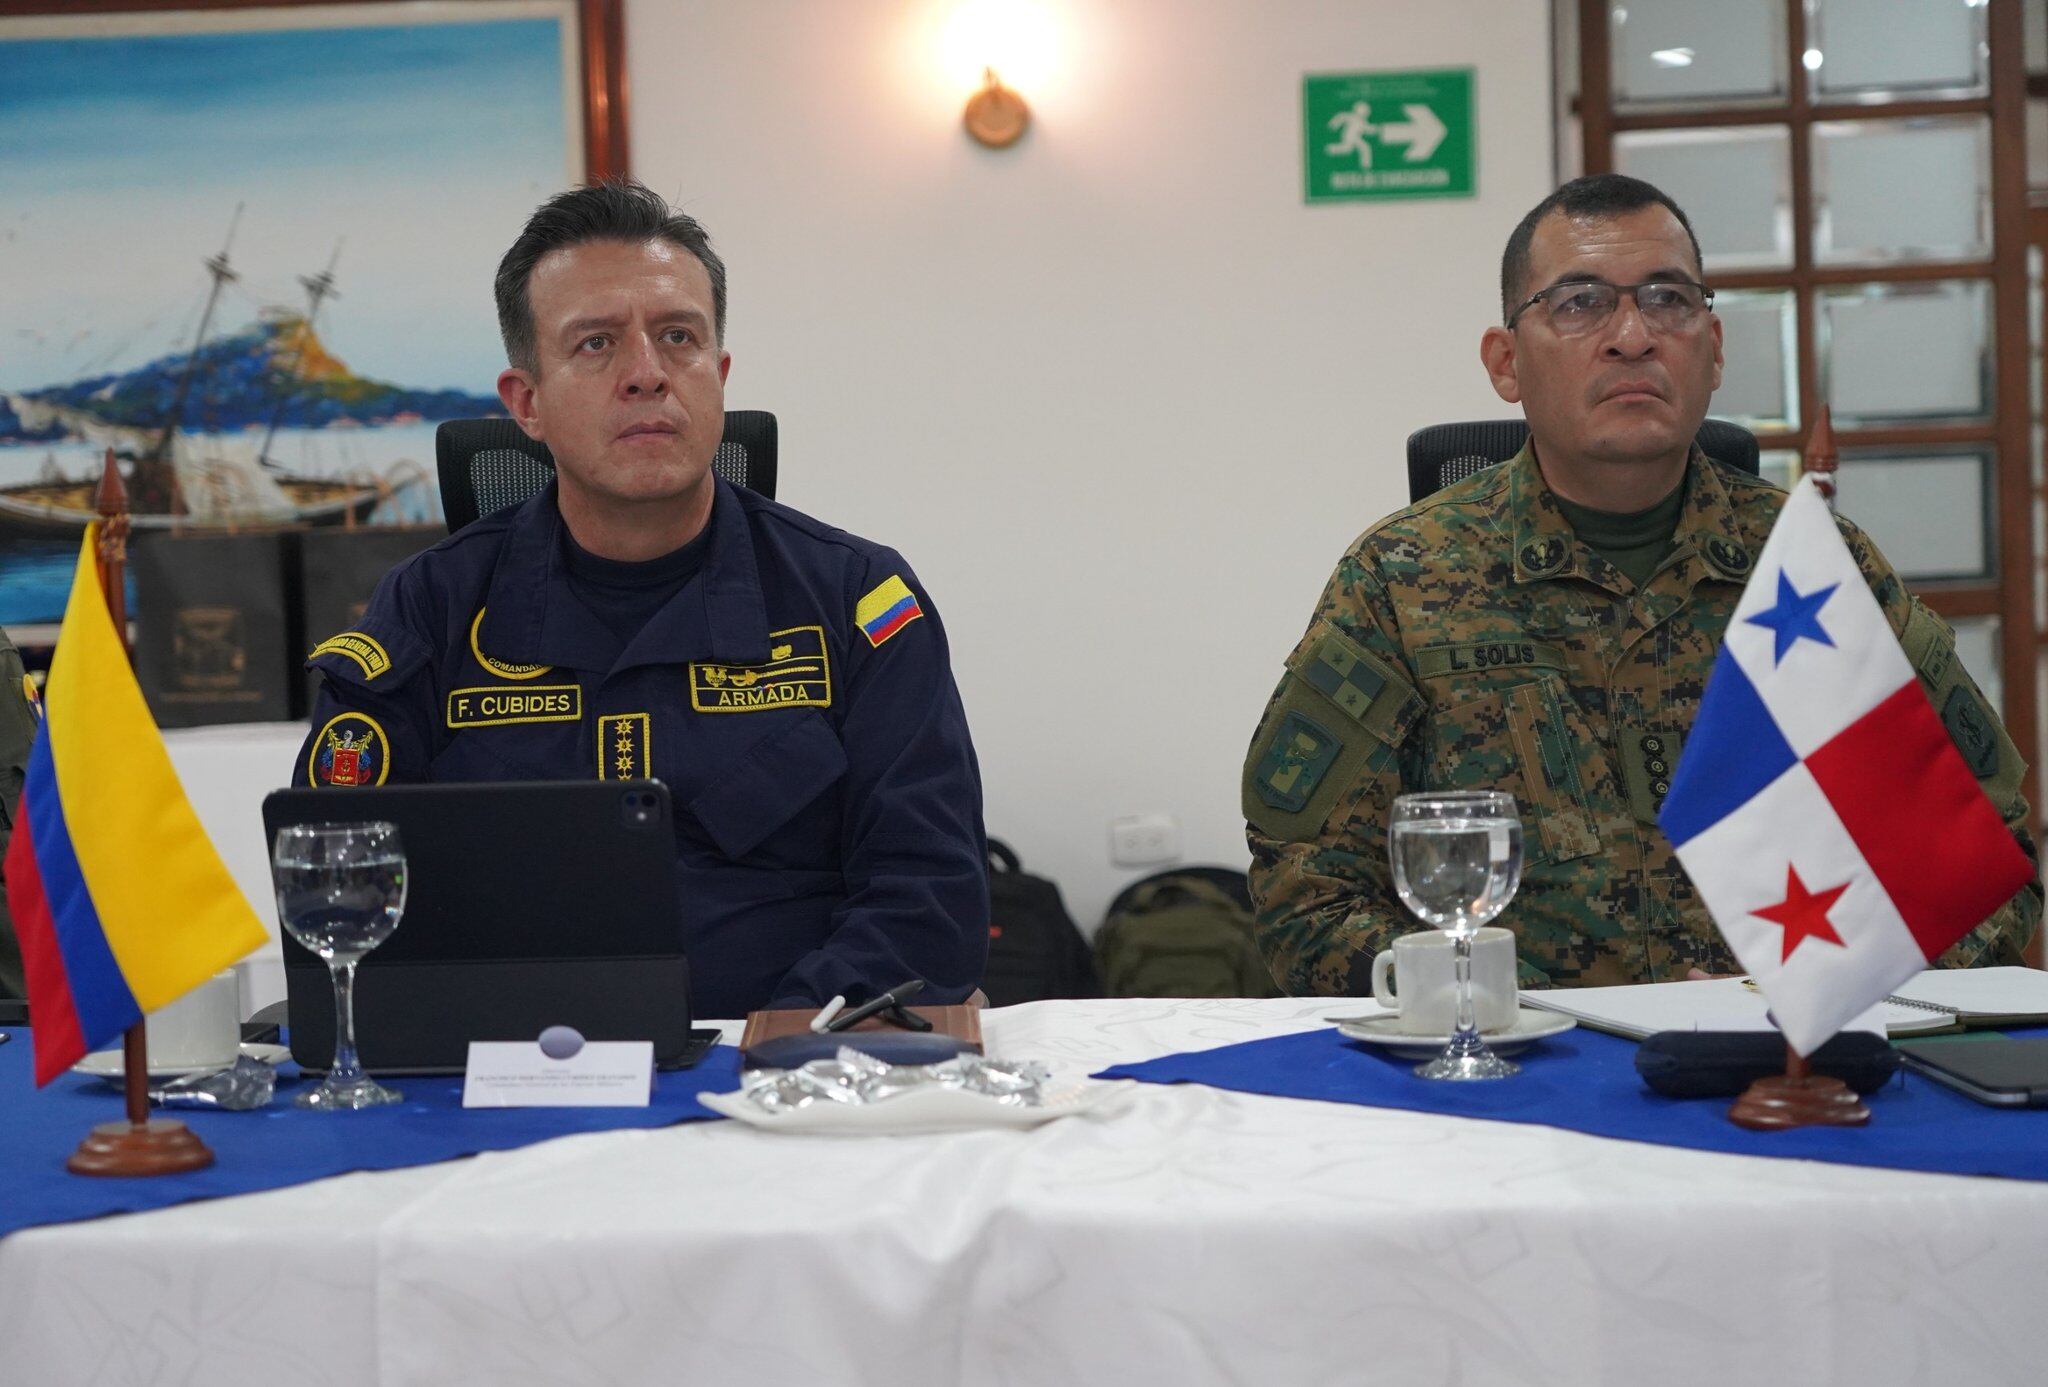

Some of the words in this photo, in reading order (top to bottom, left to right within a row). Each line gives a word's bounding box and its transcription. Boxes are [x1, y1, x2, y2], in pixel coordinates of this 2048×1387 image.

[1450, 649, 1468, 670] L.
[1474, 643, 1535, 667] SOLIS
[458, 699, 473, 718] F.
[481, 694, 571, 715] CUBIDES
[719, 684, 809, 706] ARMADA
